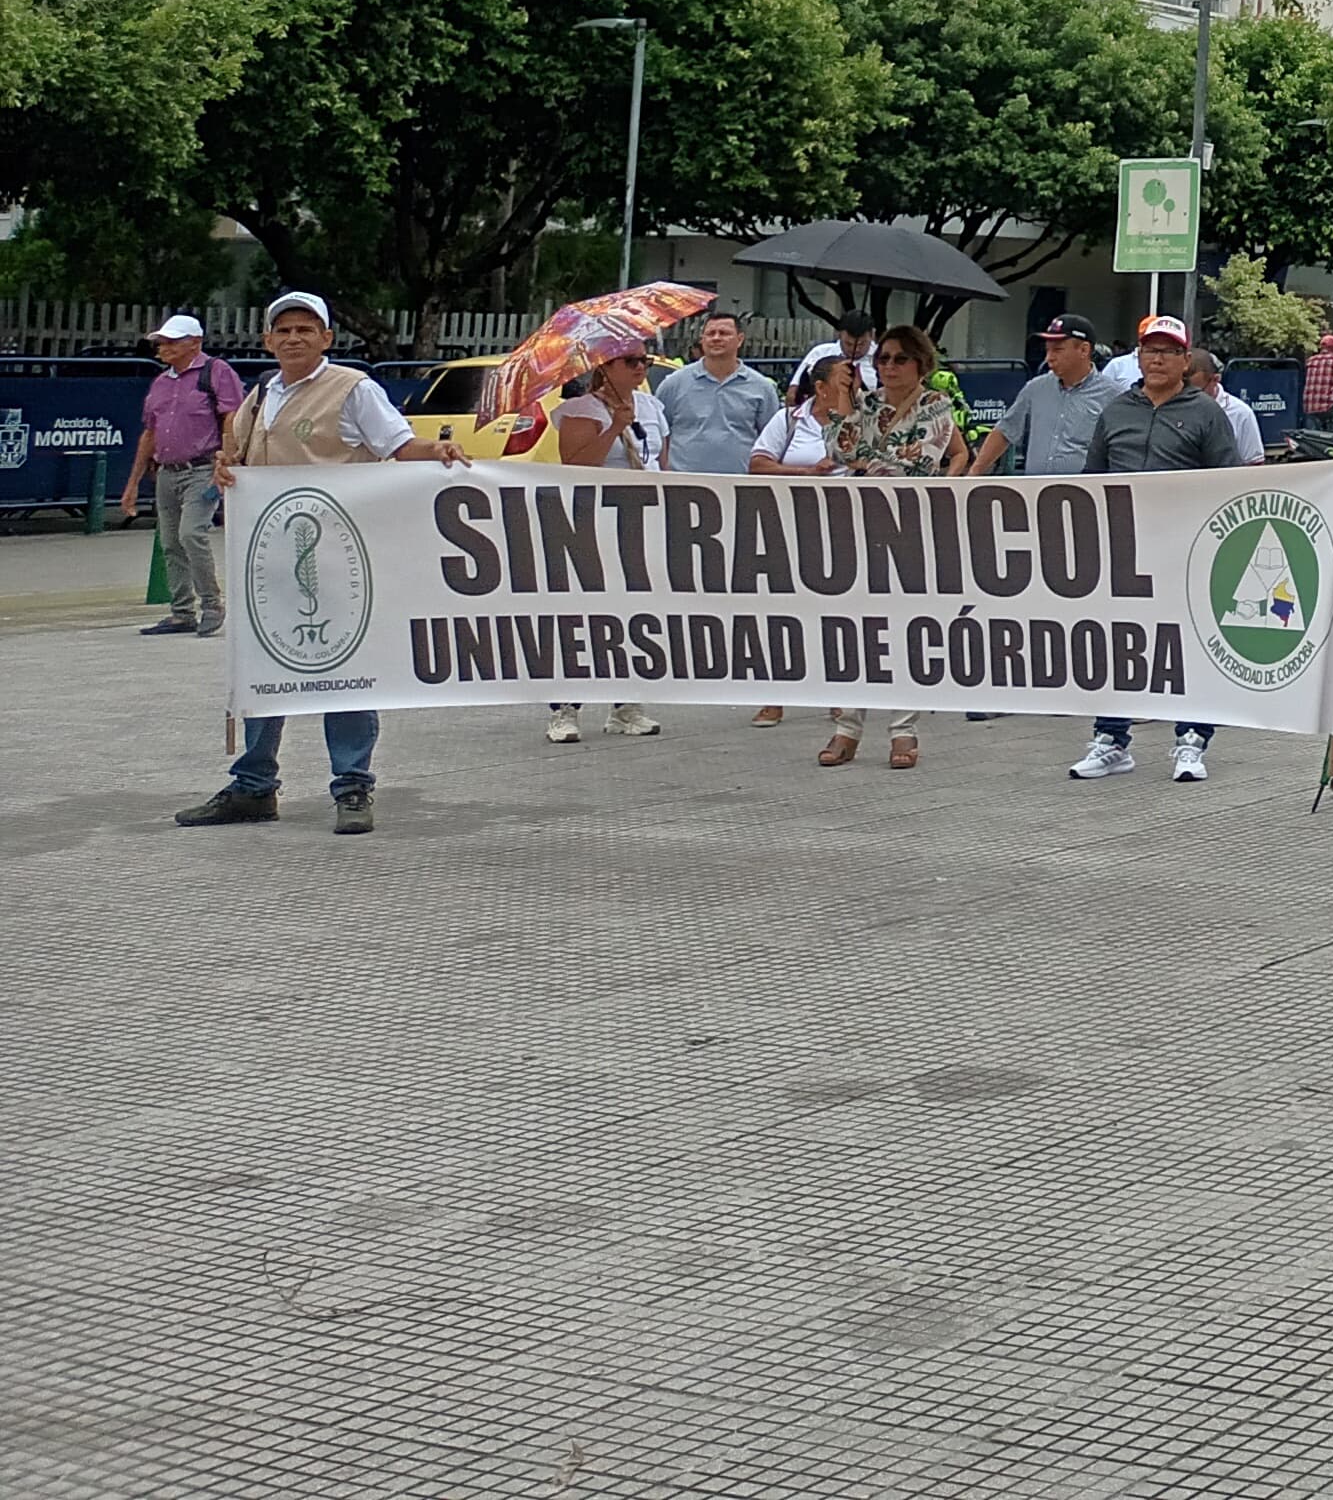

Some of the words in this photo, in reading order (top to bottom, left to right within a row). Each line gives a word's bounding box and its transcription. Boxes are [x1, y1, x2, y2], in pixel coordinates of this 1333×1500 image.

[34, 425, 124, 447] MONTERÍA
[54, 417, 93, 429] Alcaldía
[95, 417, 109, 429] de
[433, 484, 1154, 599] SINTRAUNICOL
[1208, 493, 1324, 544] SINTRAUNICOL
[410, 613, 807, 685] UNIVERSIDAD
[820, 615, 893, 684] DE
[906, 604, 1186, 695] CÓRDOBA
[1207, 633, 1263, 685] UNIVERSIDAD
[1264, 669, 1277, 685] DE
